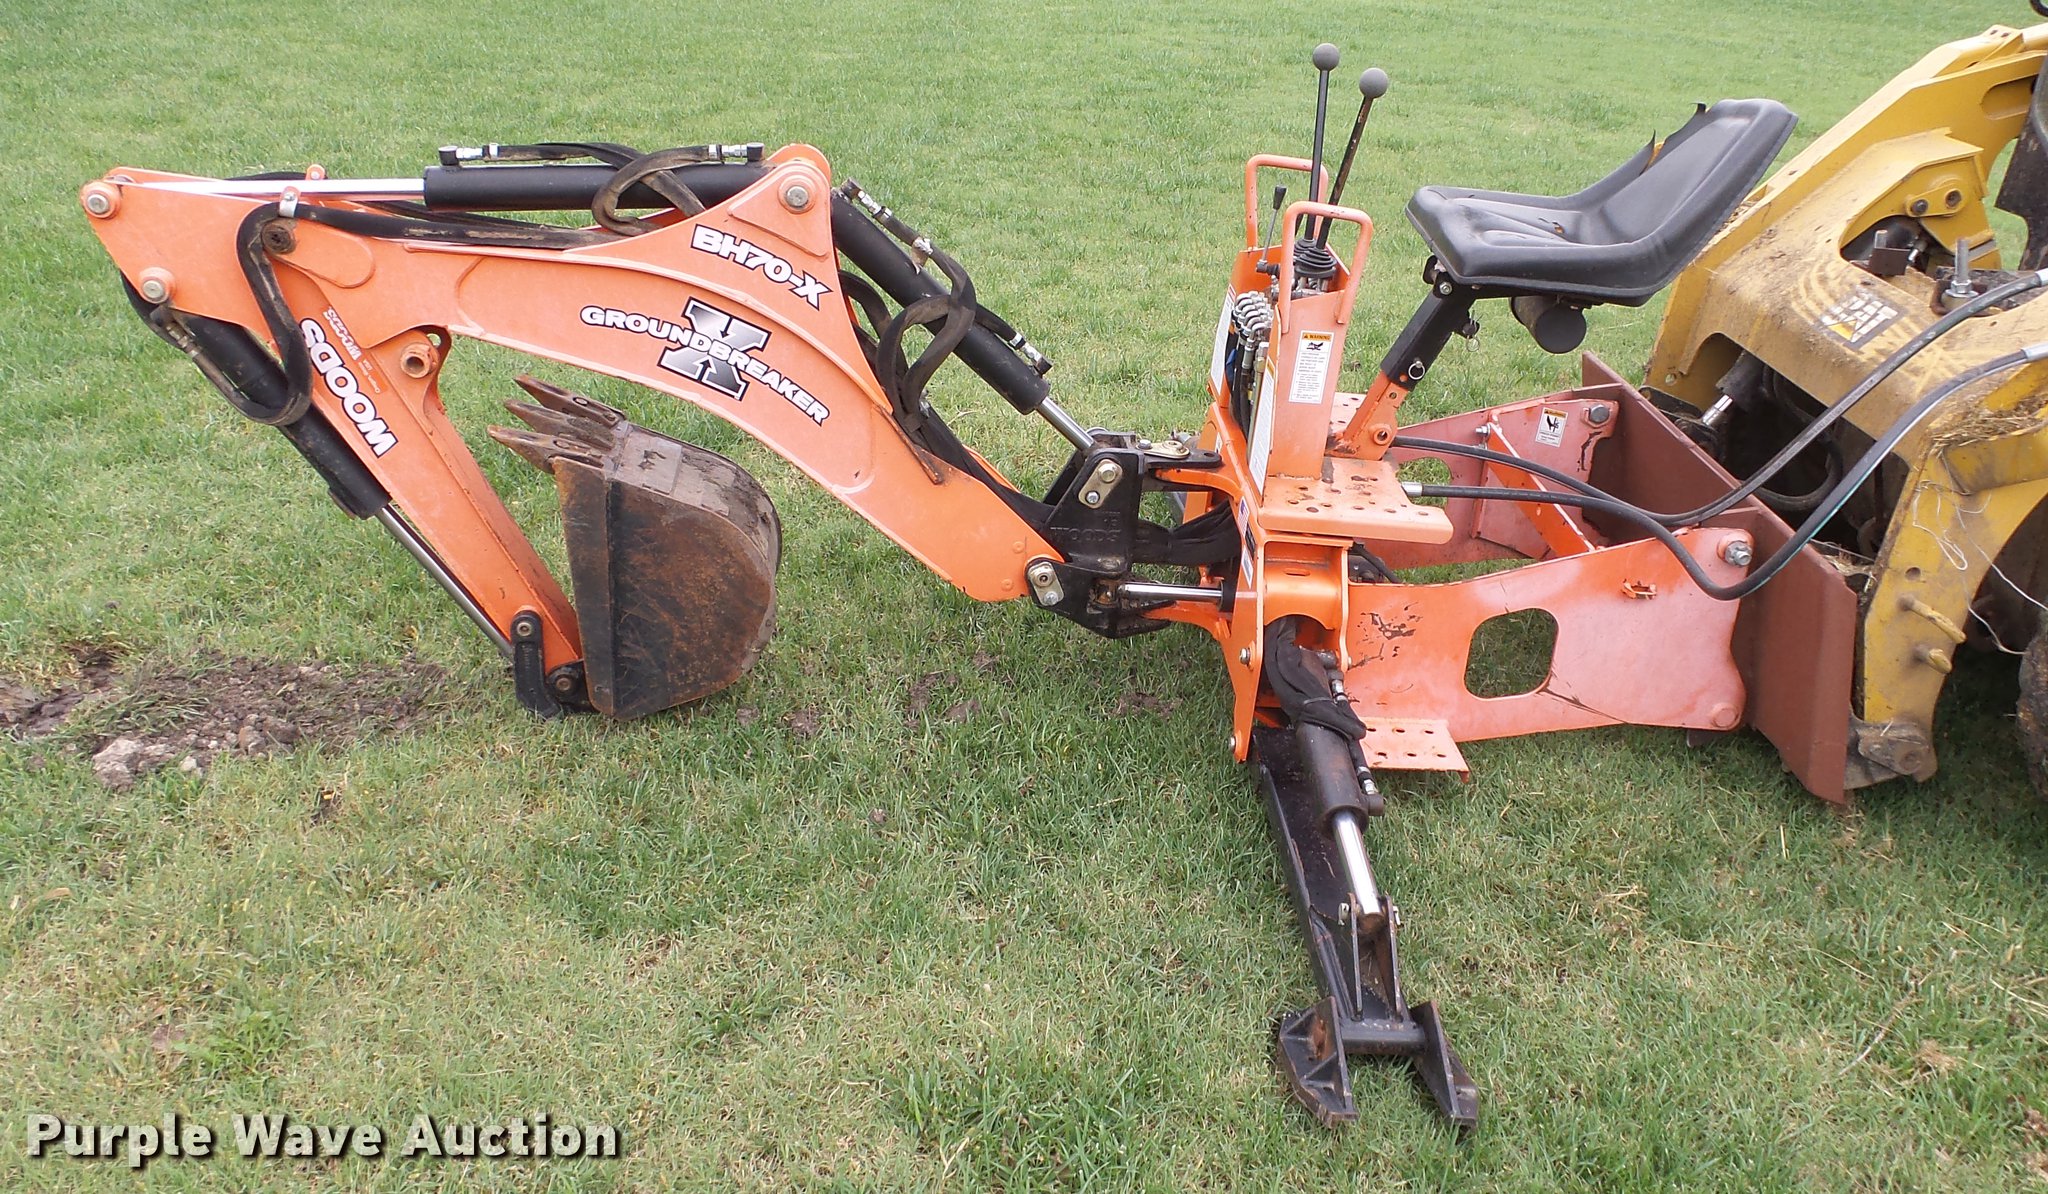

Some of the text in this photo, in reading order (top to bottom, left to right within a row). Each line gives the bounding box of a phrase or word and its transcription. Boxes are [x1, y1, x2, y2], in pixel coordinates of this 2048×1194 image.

[691, 224, 833, 310] BH70-X
[299, 318, 398, 458] WOODS
[580, 305, 830, 427] GROUNDBREAKER
